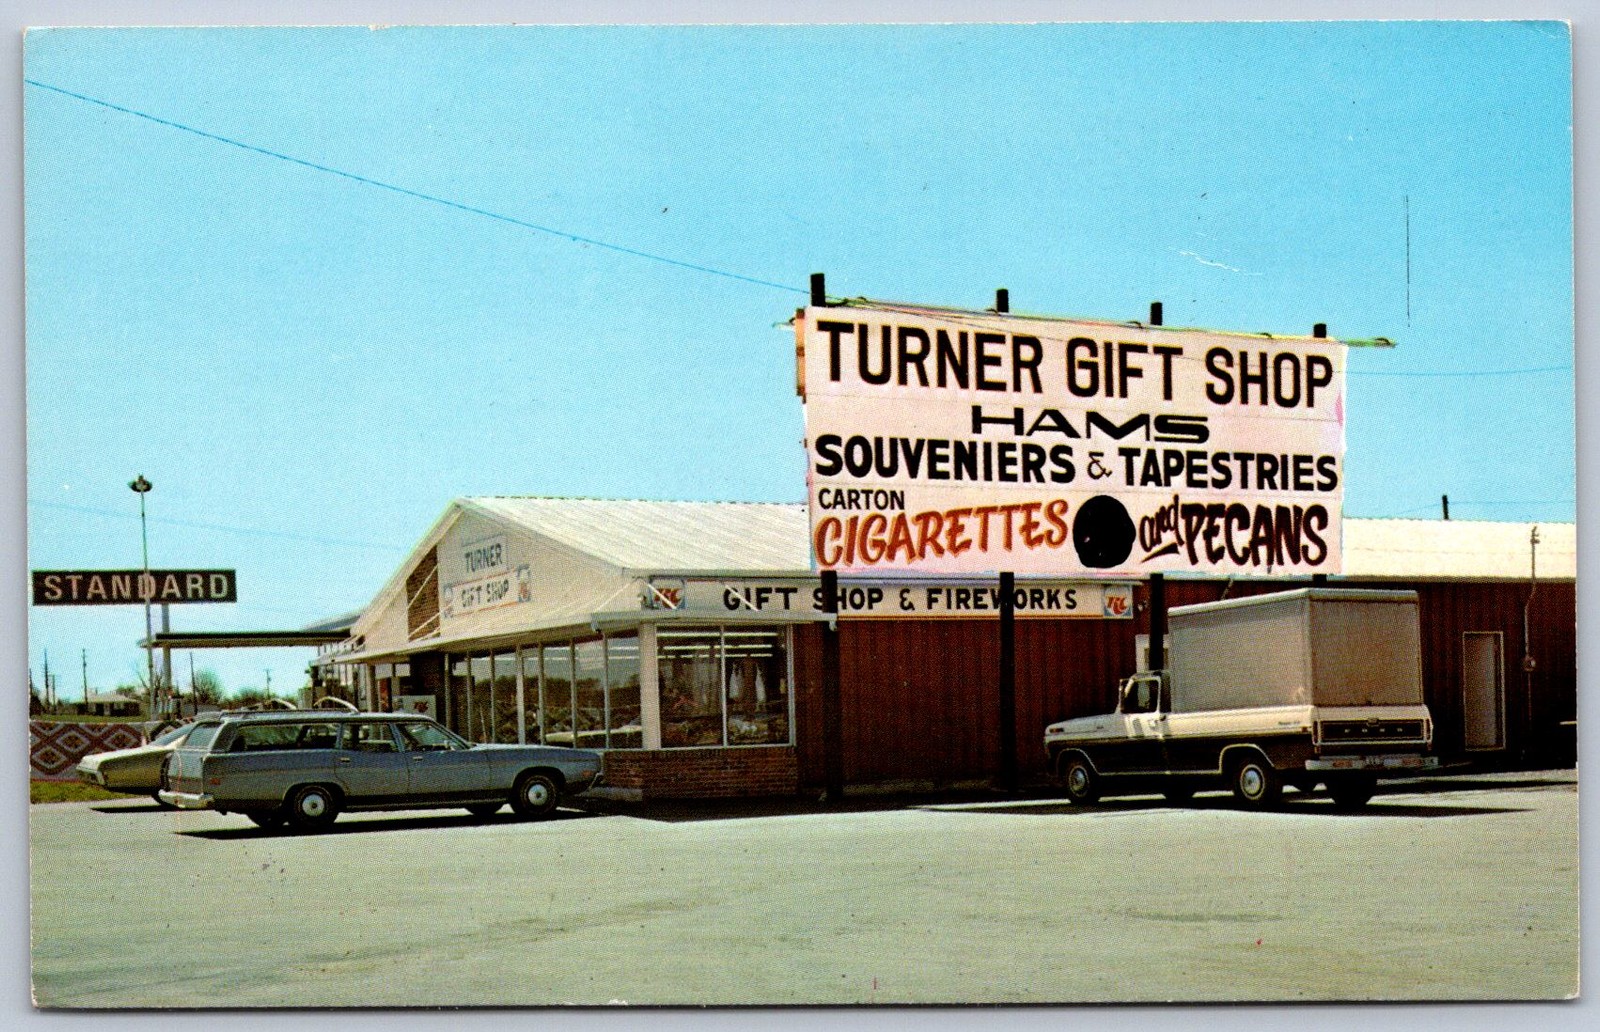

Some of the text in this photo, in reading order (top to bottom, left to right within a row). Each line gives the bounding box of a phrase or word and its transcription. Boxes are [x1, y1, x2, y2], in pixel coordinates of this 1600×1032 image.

[816, 320, 1333, 409] TURNER GIFT SHOP
[971, 405, 1210, 443] HAMS
[815, 434, 1338, 492] SOUVENIERS & TAPESTRIES
[818, 487, 906, 511] CARTON
[813, 498, 1069, 567] CIGARETTES
[1180, 502, 1328, 566] PECANS
[464, 542, 503, 573] TURNER
[43, 572, 228, 601] STANDARD
[723, 587, 798, 611] GIFT
[899, 588, 915, 611] &
